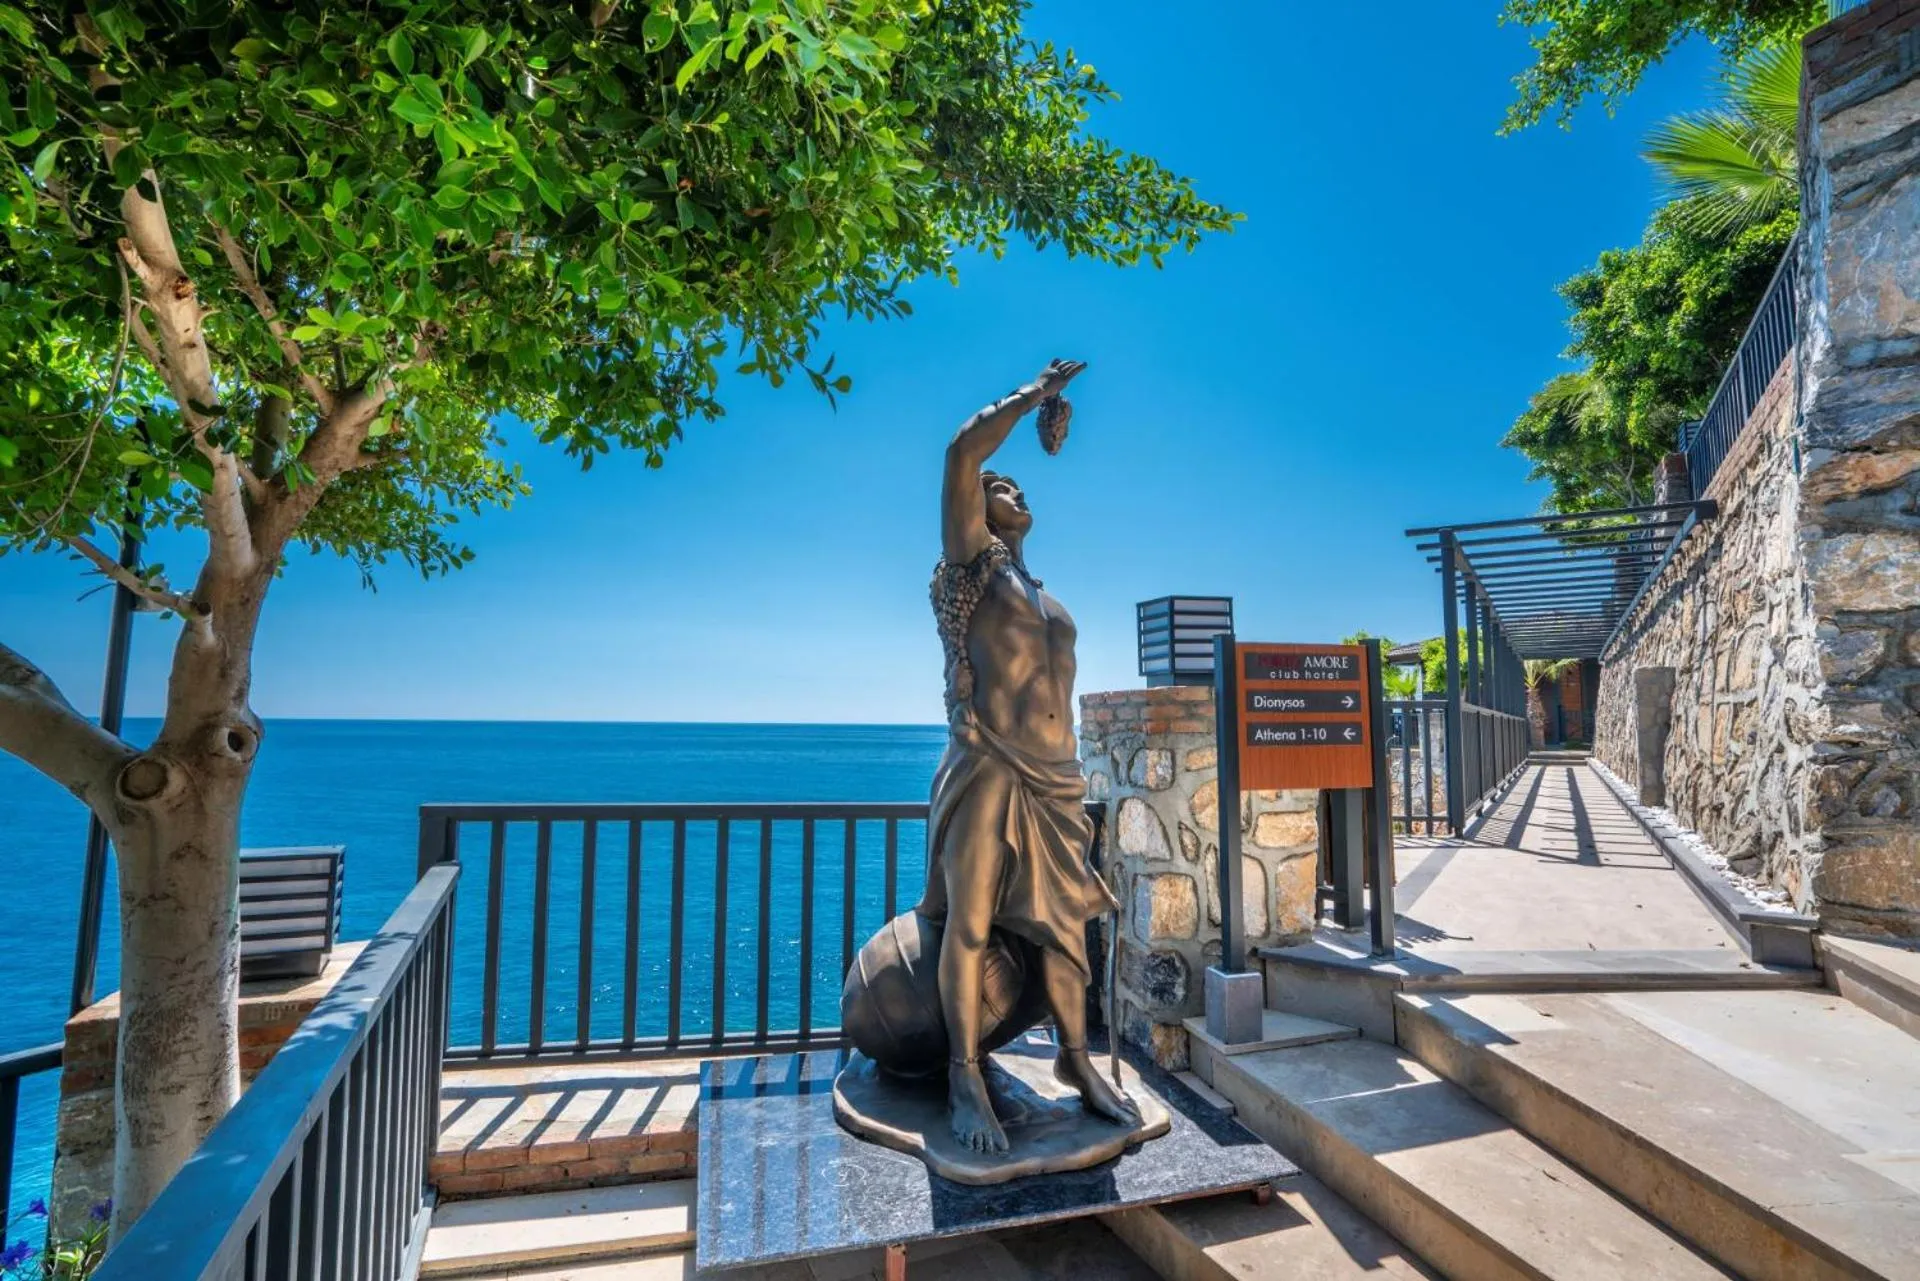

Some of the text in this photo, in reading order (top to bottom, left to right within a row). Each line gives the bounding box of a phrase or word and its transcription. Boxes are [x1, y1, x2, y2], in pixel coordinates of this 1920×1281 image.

[1303, 655, 1349, 669] AMORE
[1269, 670, 1340, 680] club hotel
[1253, 695, 1306, 711] Dionysos
[1254, 727, 1328, 741] Athena 1-10
